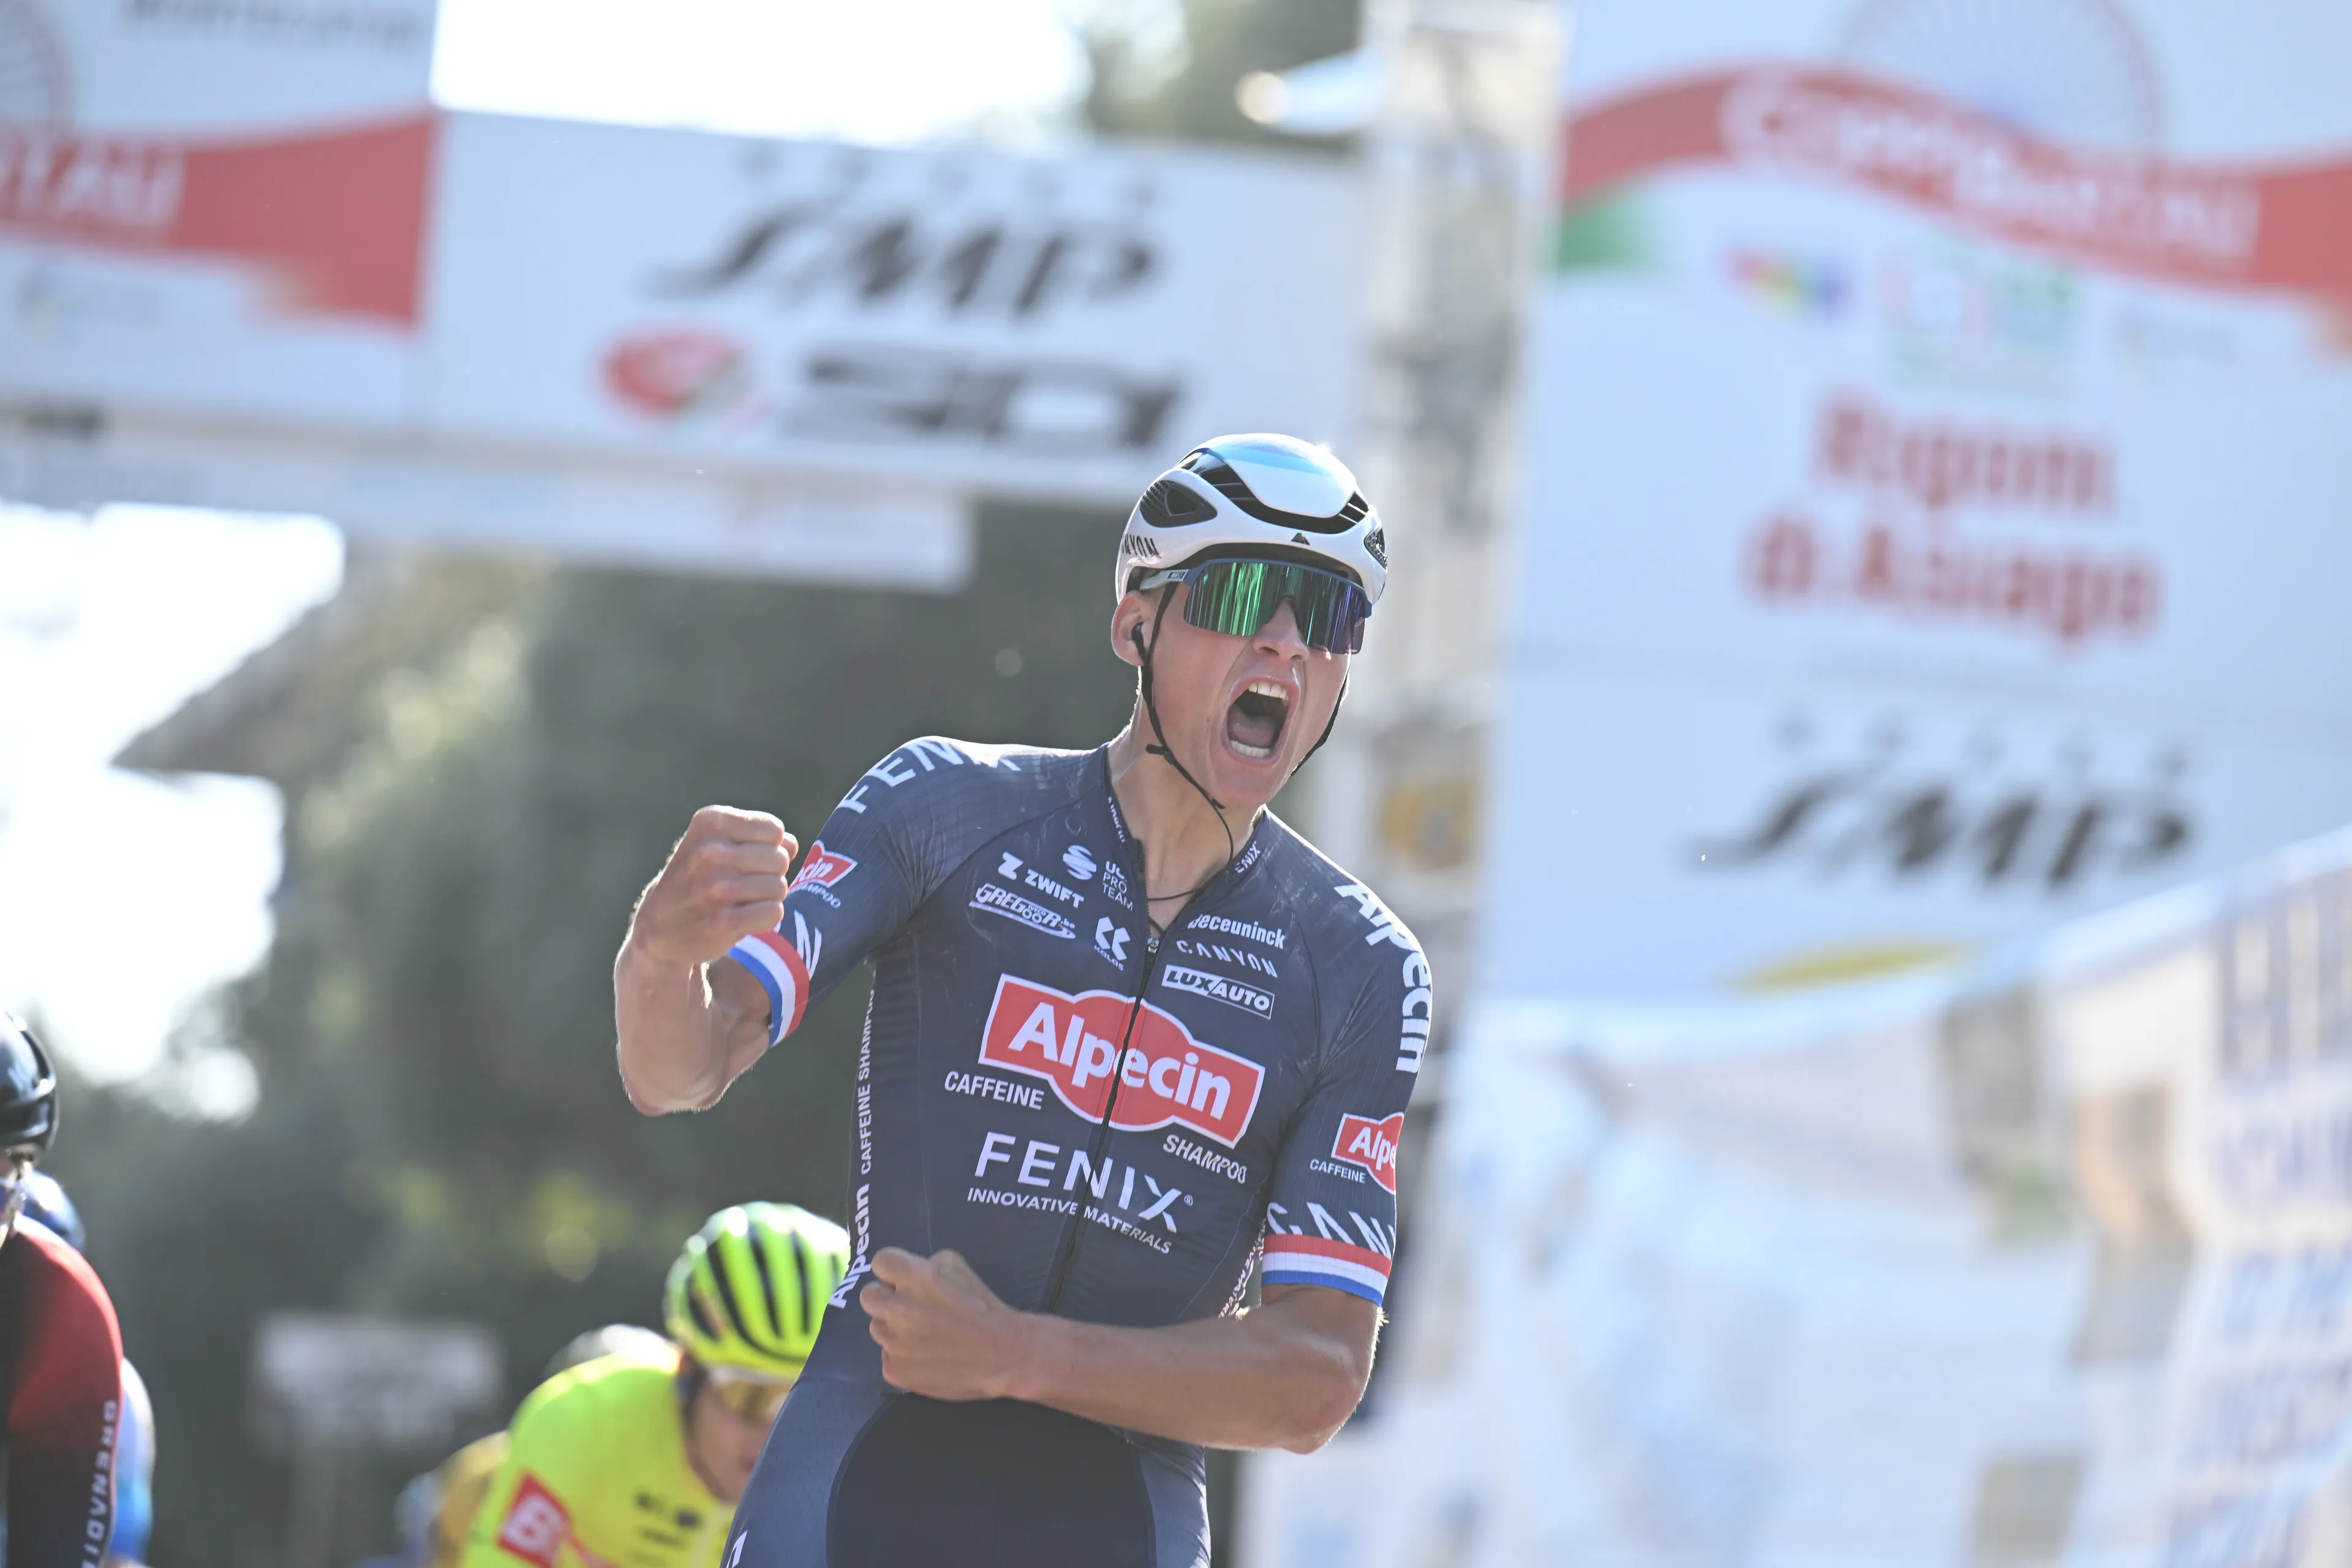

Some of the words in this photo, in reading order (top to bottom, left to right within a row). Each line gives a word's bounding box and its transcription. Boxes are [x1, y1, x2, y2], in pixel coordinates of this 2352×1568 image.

[1024, 868, 1085, 909] ZWIFT
[1102, 872, 1128, 894] PRO
[1102, 882, 1133, 912] TEAM
[1176, 940, 1278, 979] CANYON
[1334, 881, 1432, 1074] Alpecin
[1008, 1001, 1231, 1121] Alpecin
[944, 1071, 1044, 1110] CAFFEINE
[1163, 1134, 1247, 1185] SHAMPOO
[1309, 1158, 1366, 1184] CAFFEINE
[829, 1182, 872, 1310] Alpecin
[858, 1083, 872, 1175] CAFFEINE
[967, 1187, 1078, 1216] INNOVATIVE
[1083, 1204, 1172, 1255] MATERIALS
